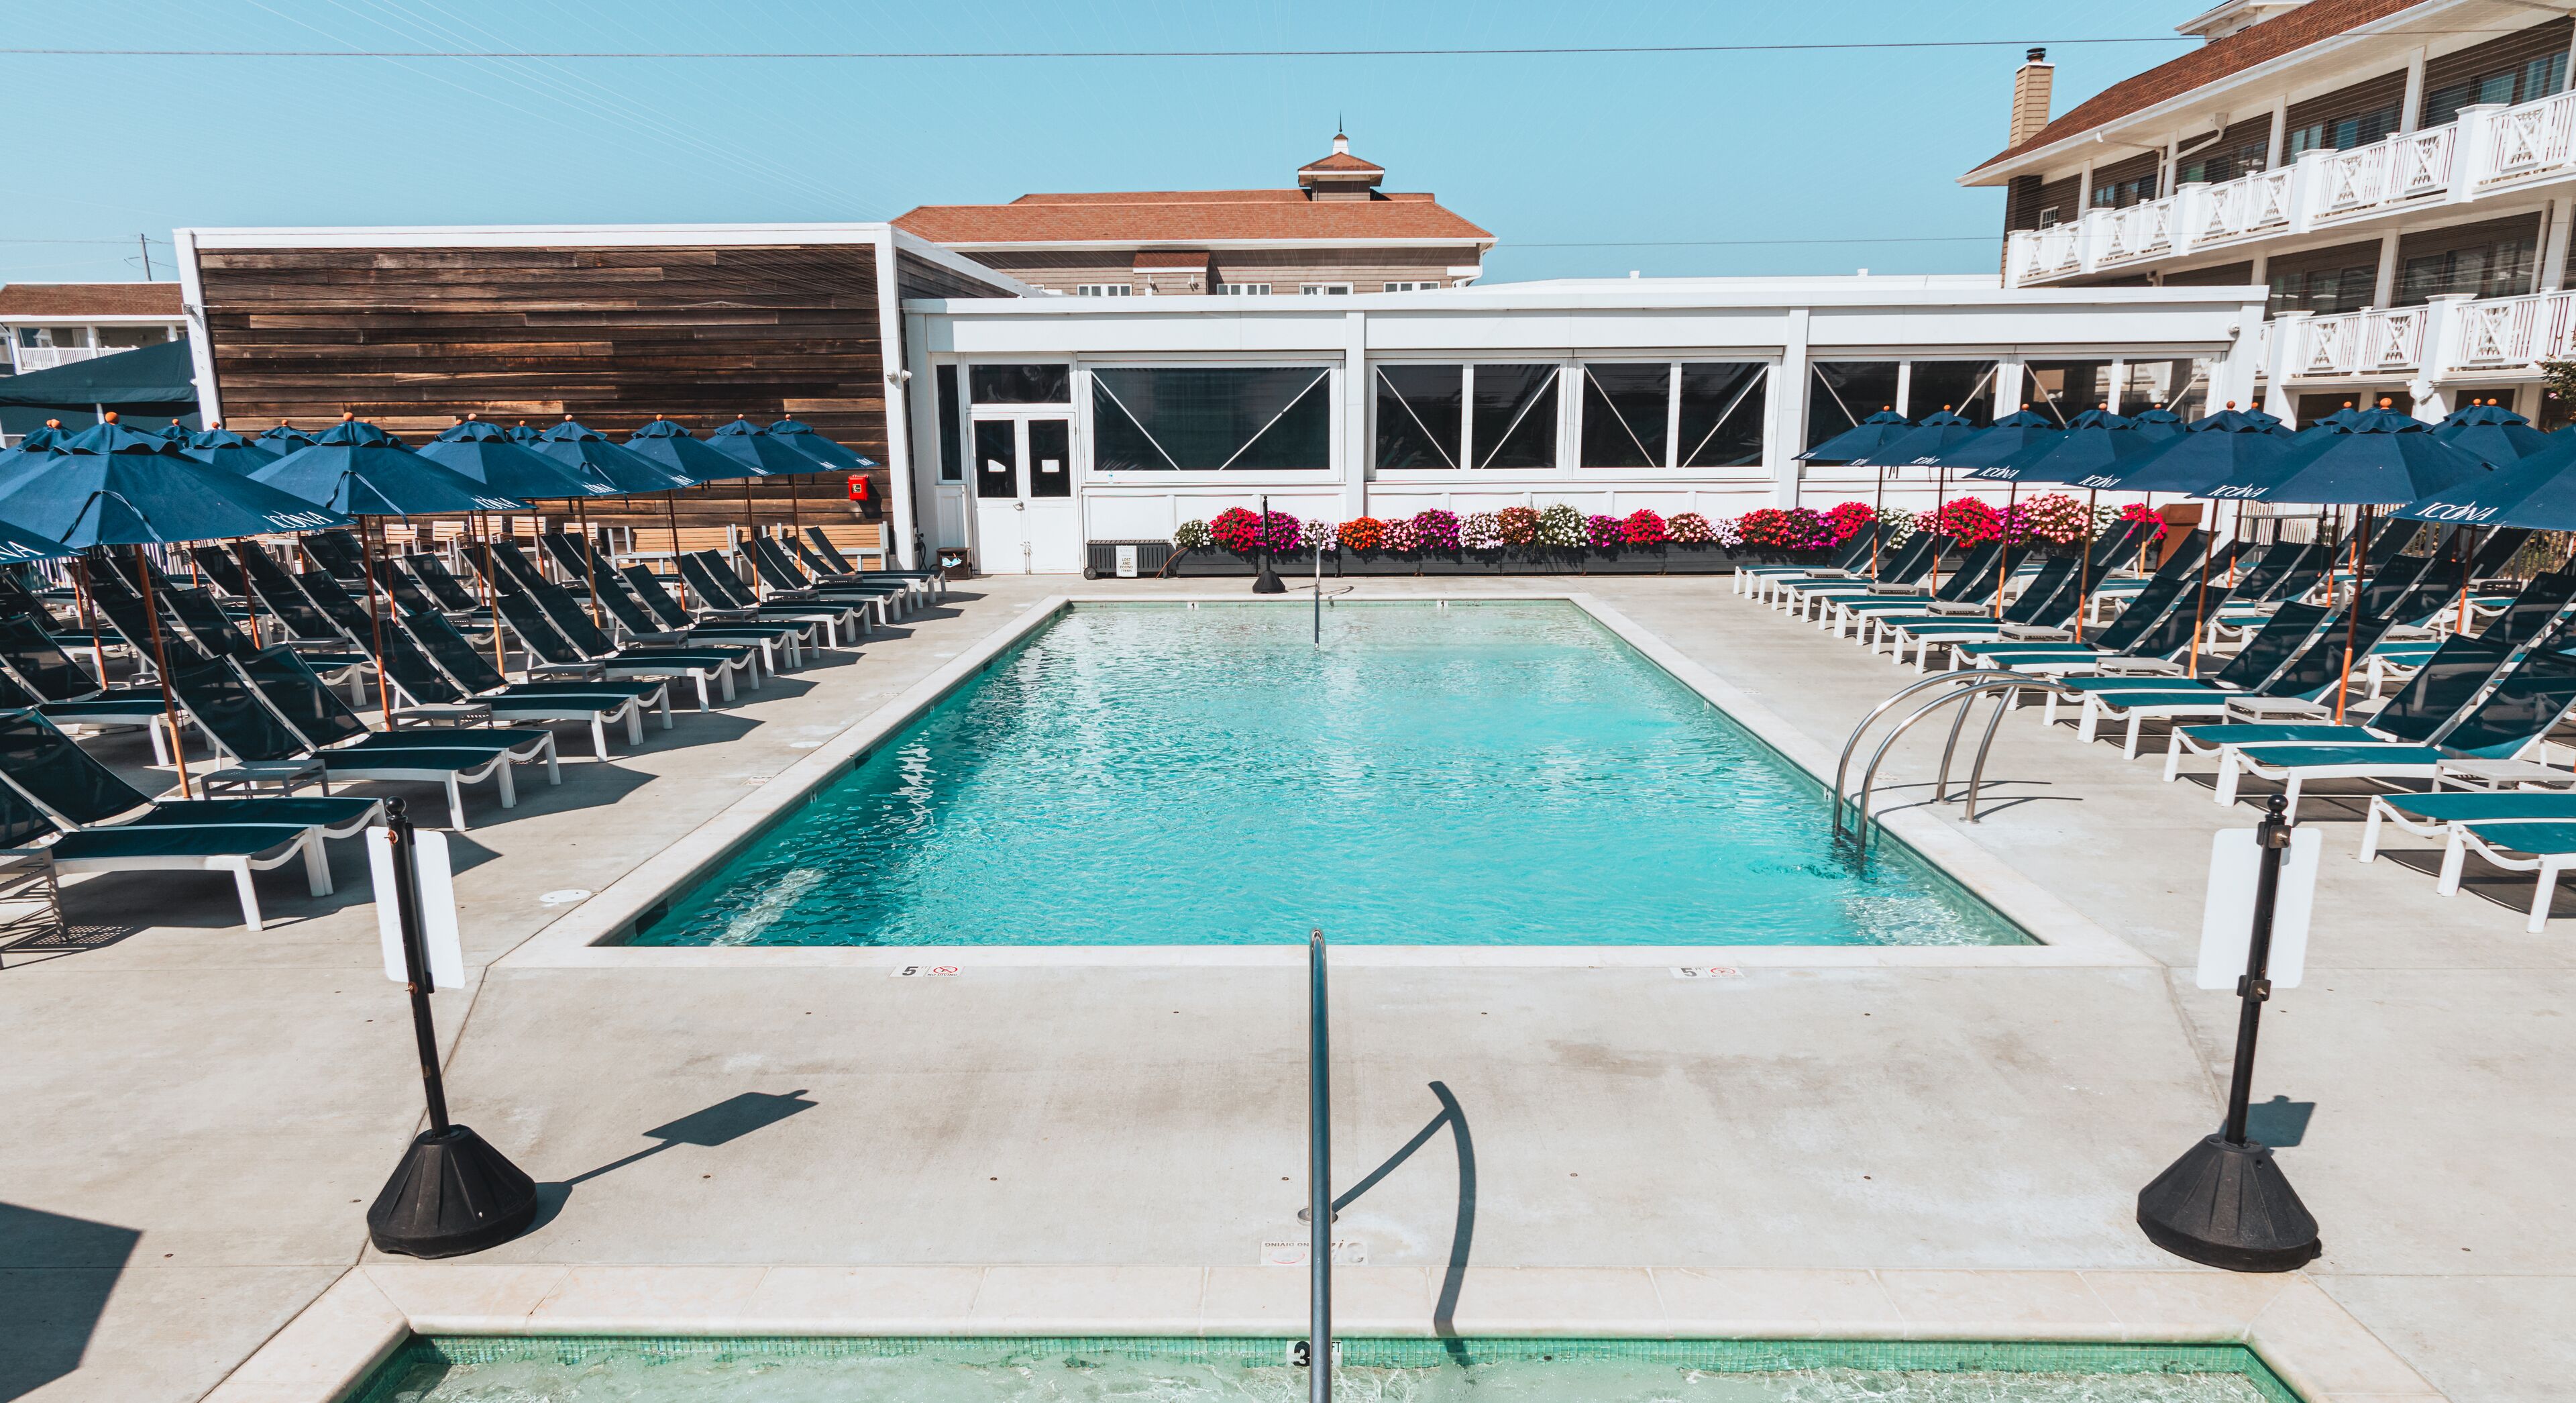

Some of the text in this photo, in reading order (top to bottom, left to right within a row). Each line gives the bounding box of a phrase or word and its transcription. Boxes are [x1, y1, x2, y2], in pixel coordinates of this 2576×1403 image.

[2207, 483, 2269, 497] ICONA
[2415, 501, 2499, 521] ICONA
[262, 510, 334, 528] ICONA
[902, 966, 918, 976] 5
[1680, 968, 1697, 977] 5
